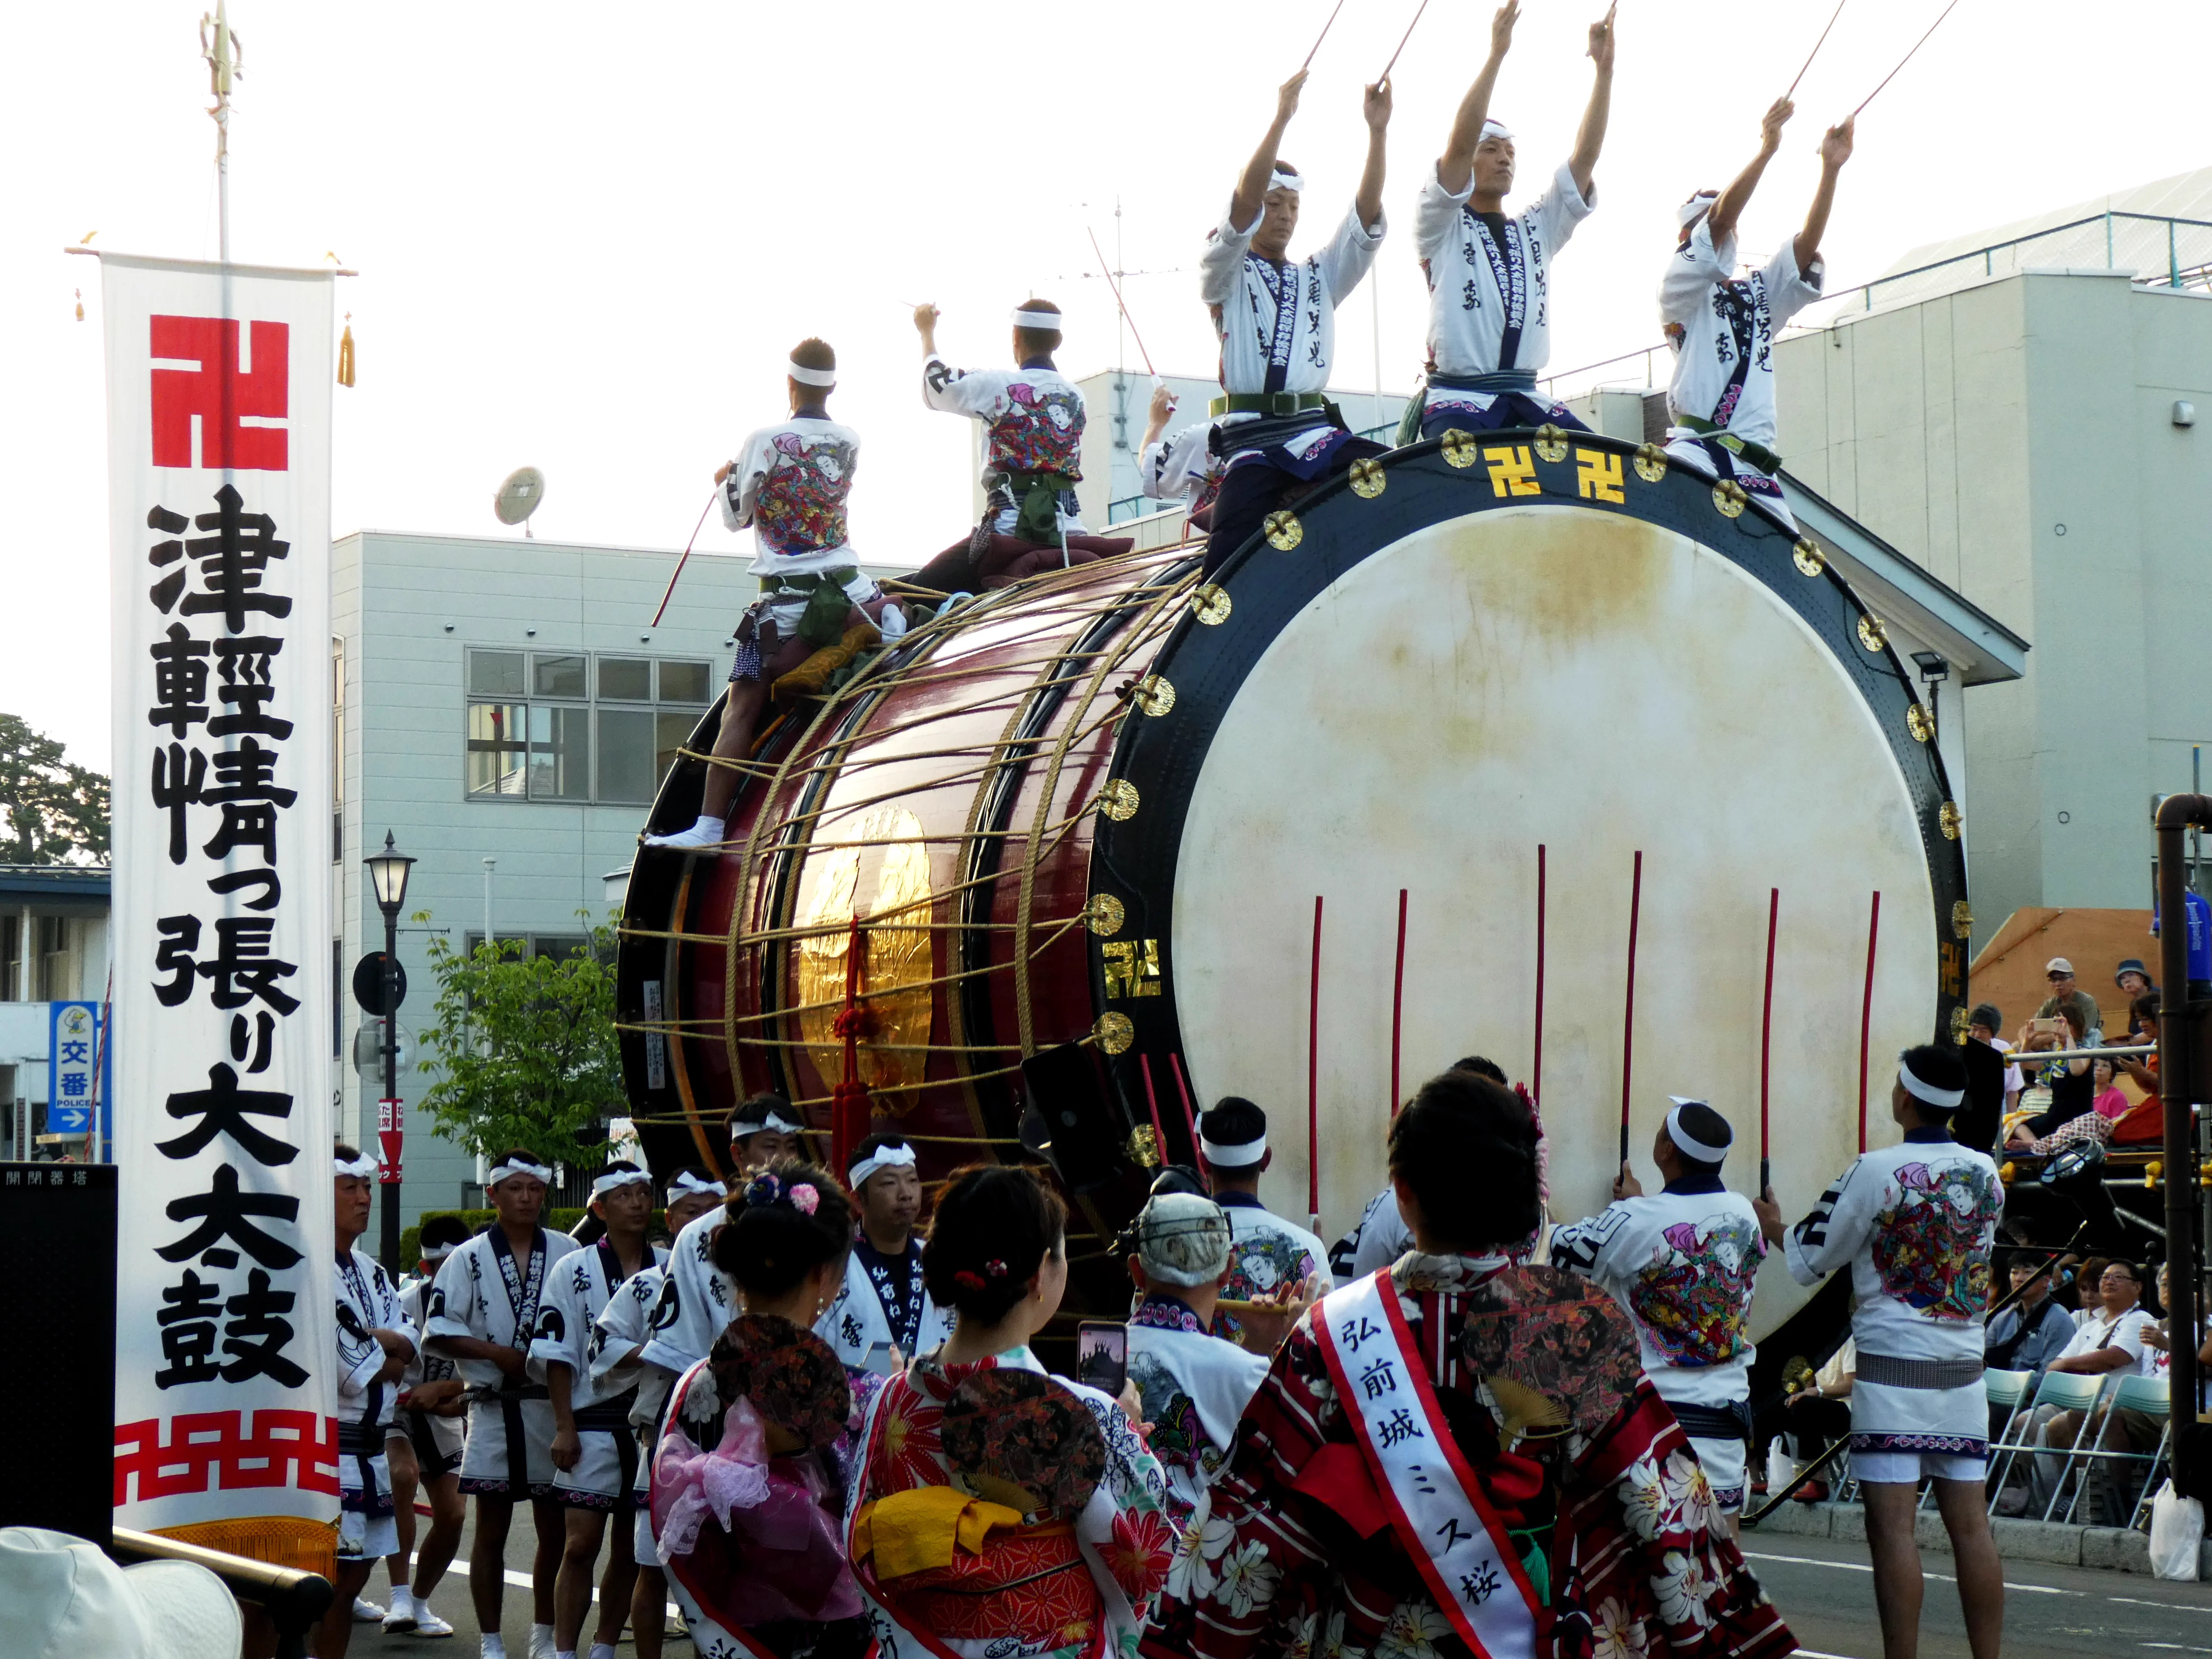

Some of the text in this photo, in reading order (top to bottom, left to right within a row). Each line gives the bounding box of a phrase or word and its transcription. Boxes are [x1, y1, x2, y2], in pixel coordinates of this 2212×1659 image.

[61, 1040, 88, 1096] 交番
[6, 1170, 87, 1186] 開閉器塔
[1340, 1317, 1502, 1605] 弘前城ミス桜
